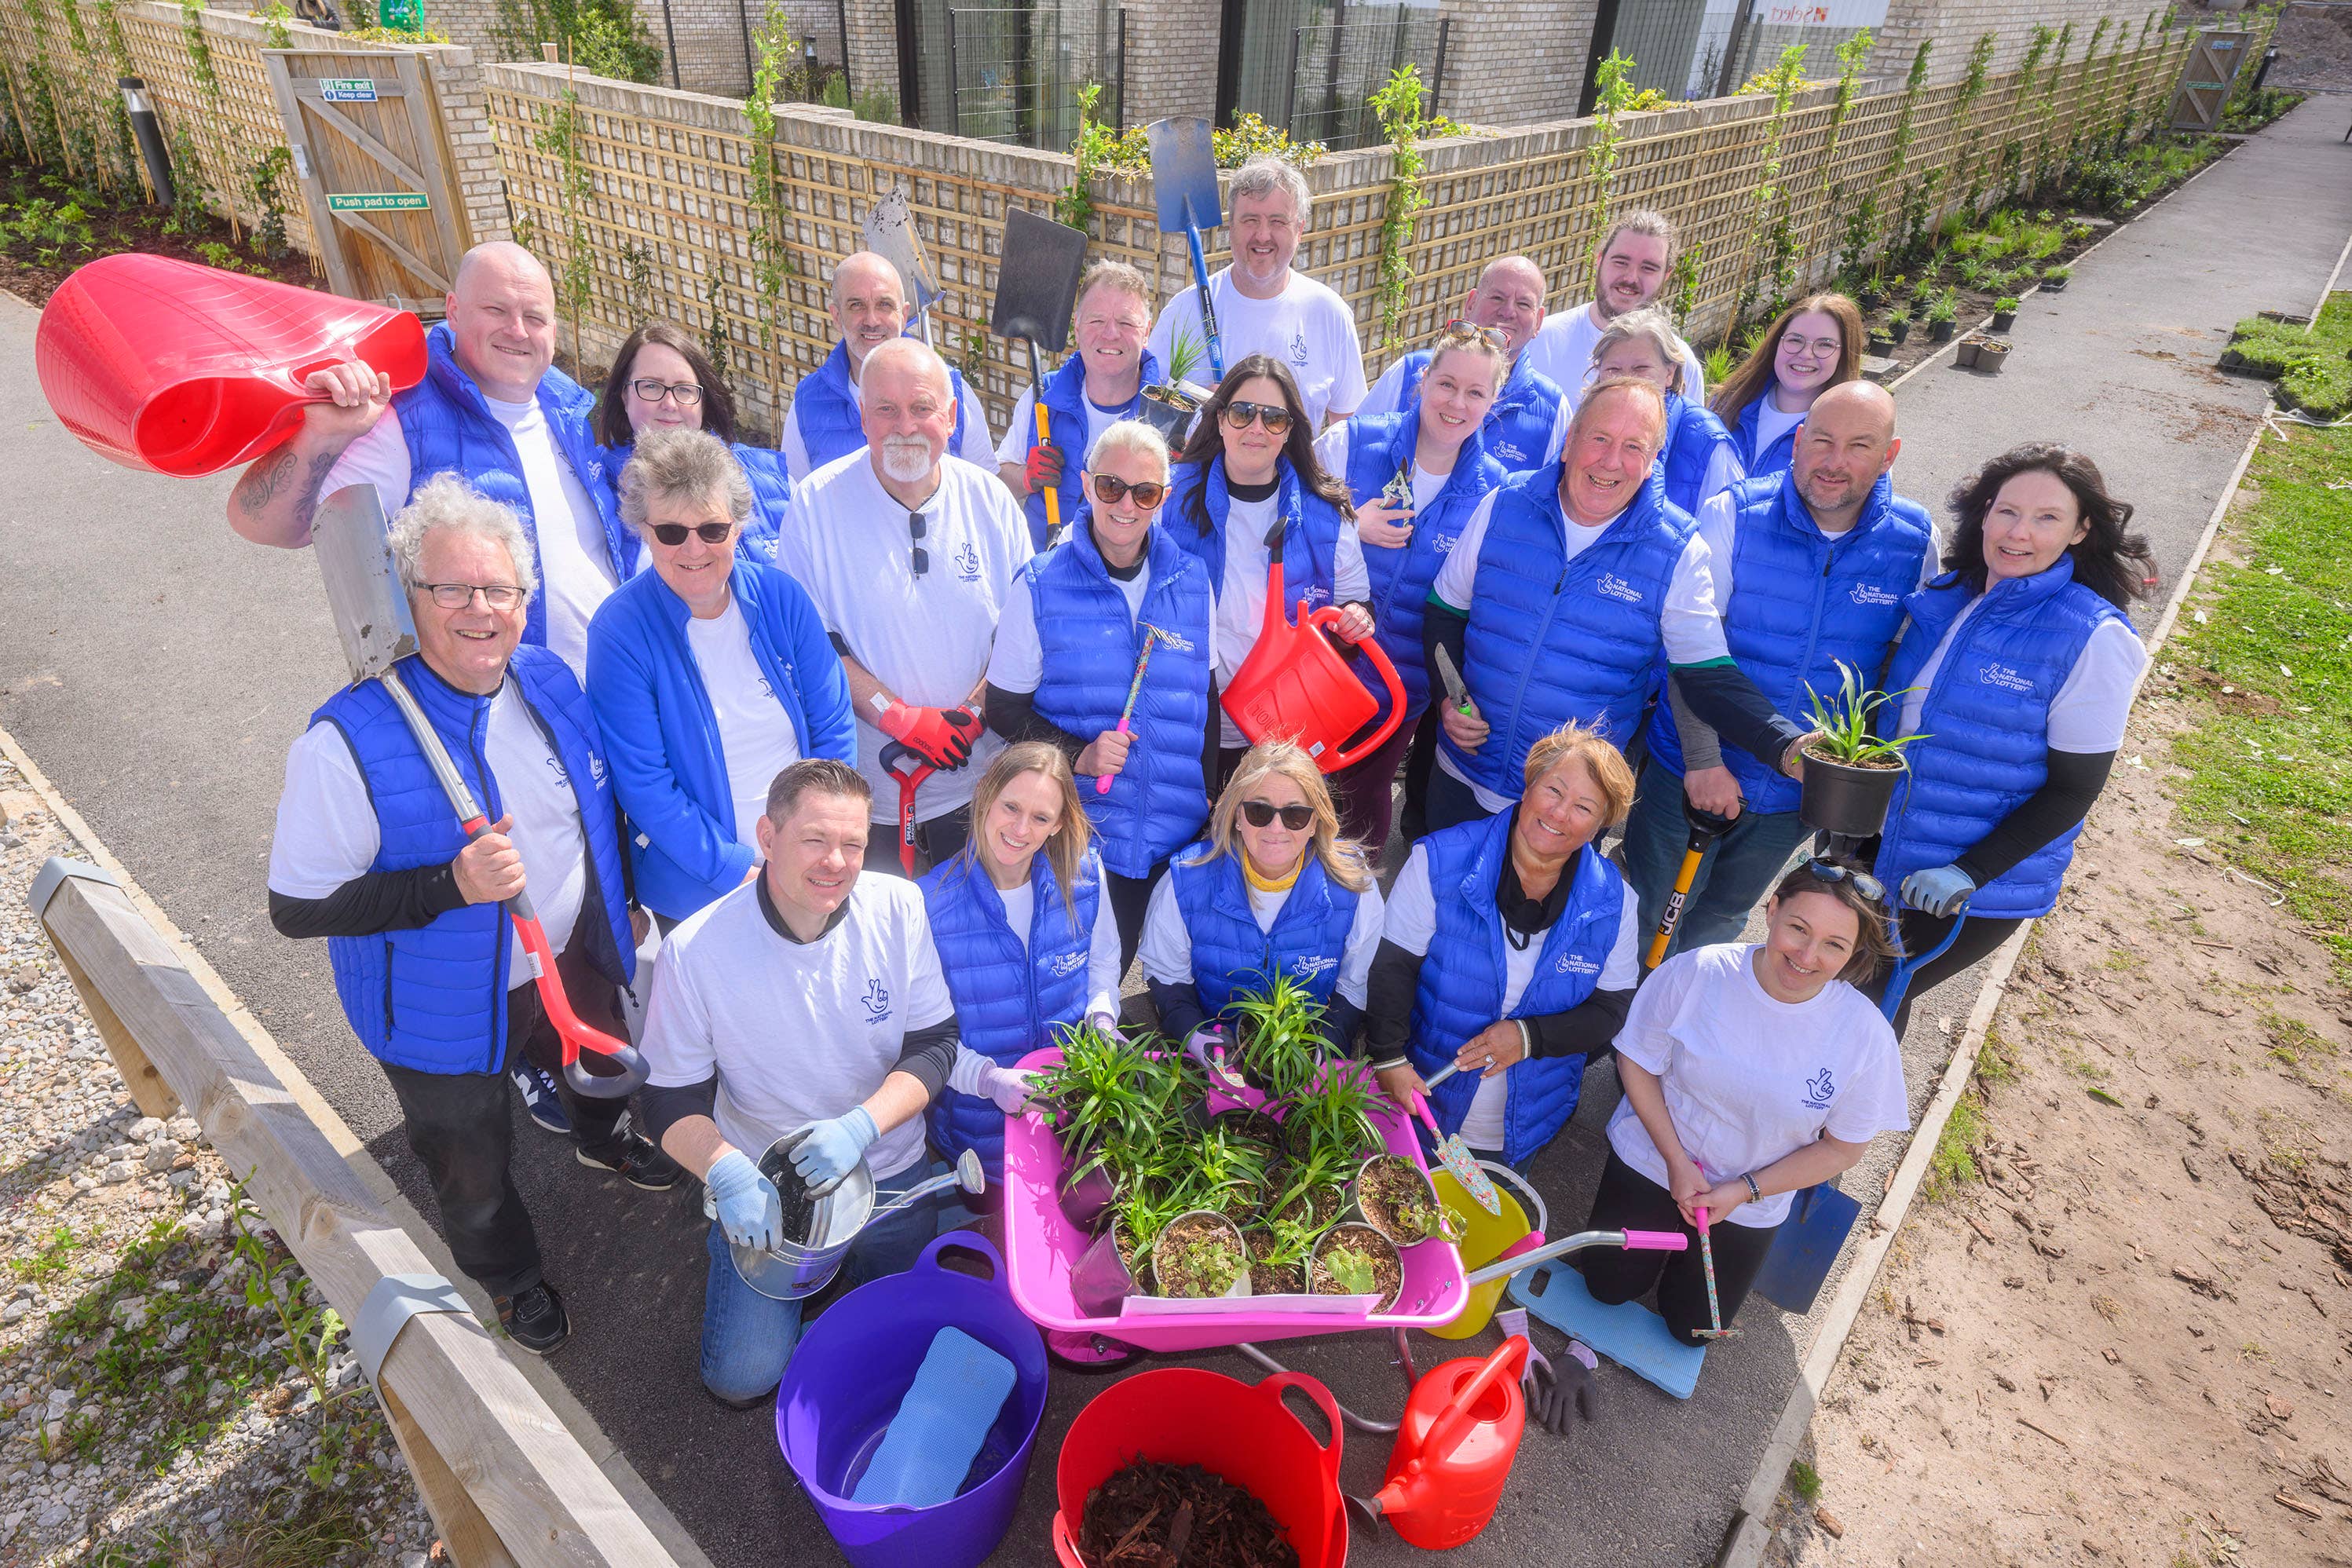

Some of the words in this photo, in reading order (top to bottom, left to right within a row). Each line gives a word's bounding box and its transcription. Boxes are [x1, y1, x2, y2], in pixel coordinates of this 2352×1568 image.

[354, 81, 371, 90] exit
[335, 198, 361, 207] Push
[364, 197, 382, 207] pad
[397, 198, 422, 207] open
[1506, 448, 1527, 459] NATIONAL
[1616, 578, 1628, 587] THE
[1612, 583, 1643, 599] NATIONAL
[1999, 673, 2034, 687] NATIONAL
[1661, 891, 1685, 934] JCB
[1066, 951, 1077, 959] THE
[1309, 958, 1338, 967] NATIONAL
[1569, 960, 1600, 969] NATIONAL
